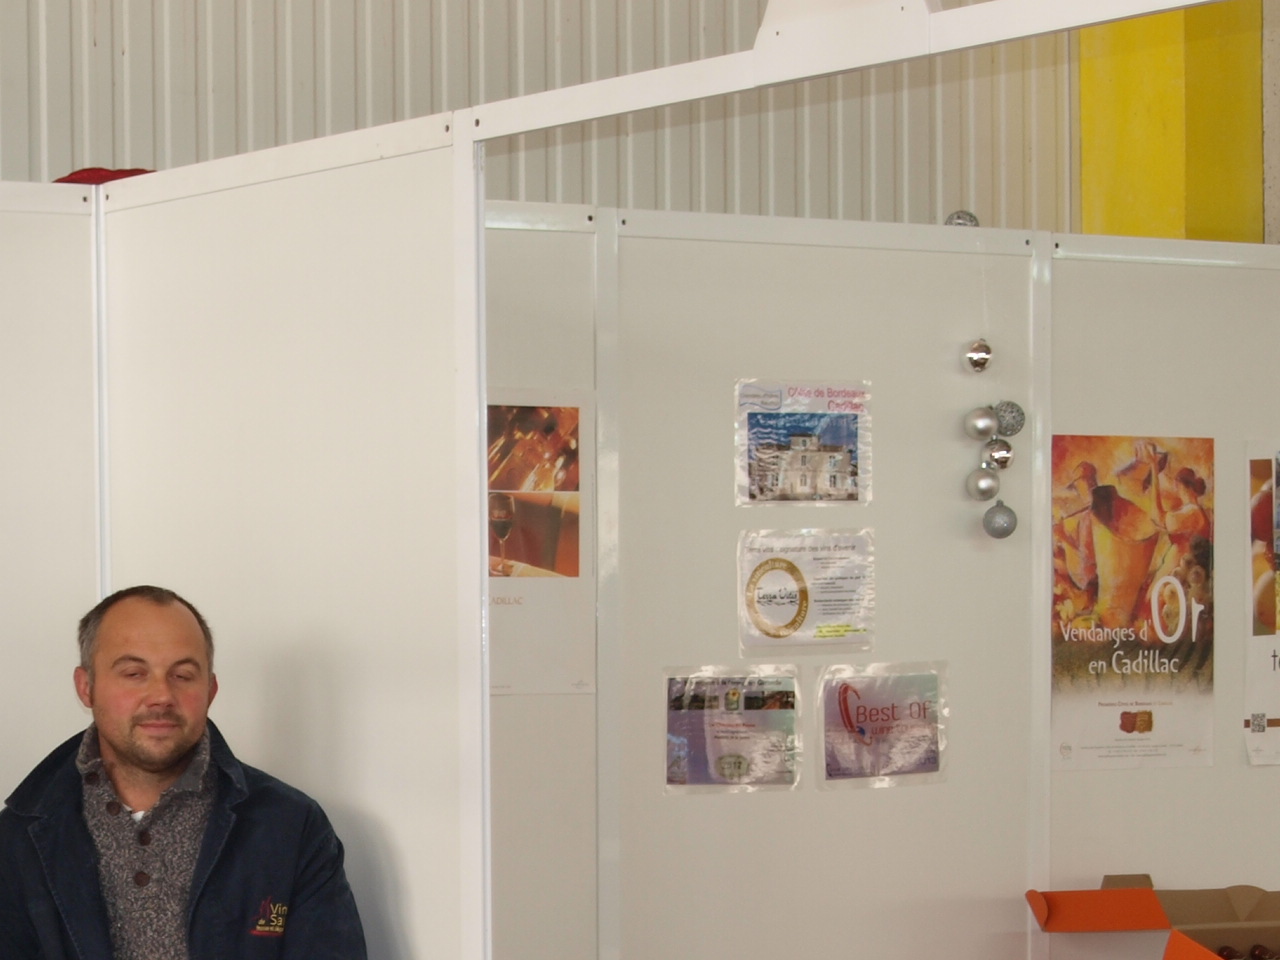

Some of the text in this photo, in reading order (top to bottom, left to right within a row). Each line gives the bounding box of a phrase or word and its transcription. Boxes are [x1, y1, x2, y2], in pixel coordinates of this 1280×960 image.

[1059, 620, 1136, 648] Vendanges
[1088, 649, 1180, 675] en Cadillac
[855, 699, 932, 724] Best Of
